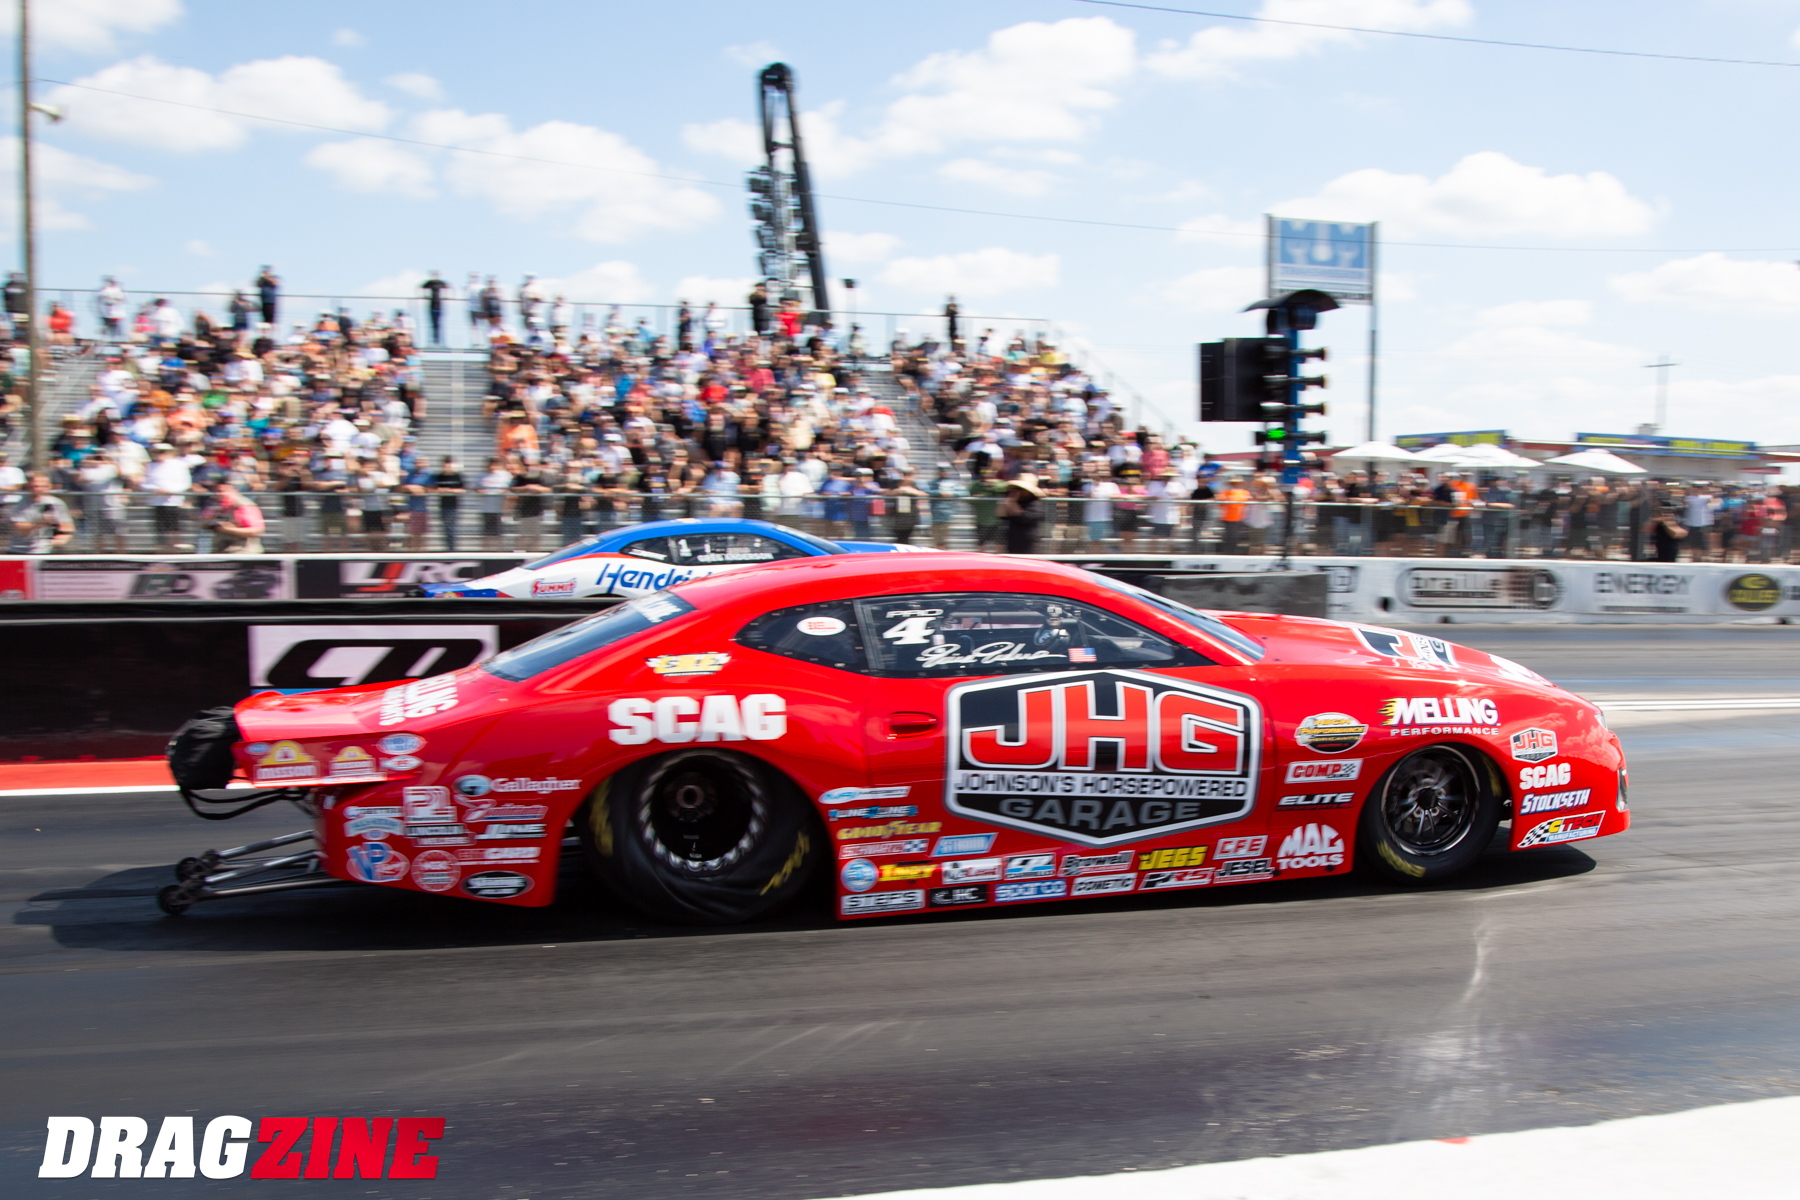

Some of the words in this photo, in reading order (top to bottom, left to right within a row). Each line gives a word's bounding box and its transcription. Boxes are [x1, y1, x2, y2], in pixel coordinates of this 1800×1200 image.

[1594, 572, 1694, 594] ENERGY
[882, 616, 938, 646] 4
[608, 693, 788, 746] SCAG
[1391, 697, 1499, 726] MELLING
[962, 680, 1245, 776] JHG
[1390, 726, 1500, 738] PERFORMANCE
[1514, 731, 1554, 750] JHG
[1293, 763, 1342, 779] COMP
[1520, 763, 1571, 790] SCAG
[489, 776, 582, 795] Gallagher
[954, 772, 1076, 794] JOHNSON'S
[1080, 775, 1248, 798] HORSEPOWERED
[1279, 793, 1355, 806] ELITE
[1520, 788, 1592, 816] STOCKSETH
[999, 798, 1202, 832] GARAGE
[1220, 838, 1264, 855] CFE
[1277, 823, 1345, 858] MAC
[1138, 845, 1208, 871] JEGS
[1216, 859, 1274, 876] JESEL
[1277, 854, 1344, 870] TOOLS
[1075, 877, 1134, 892] COMETIC
